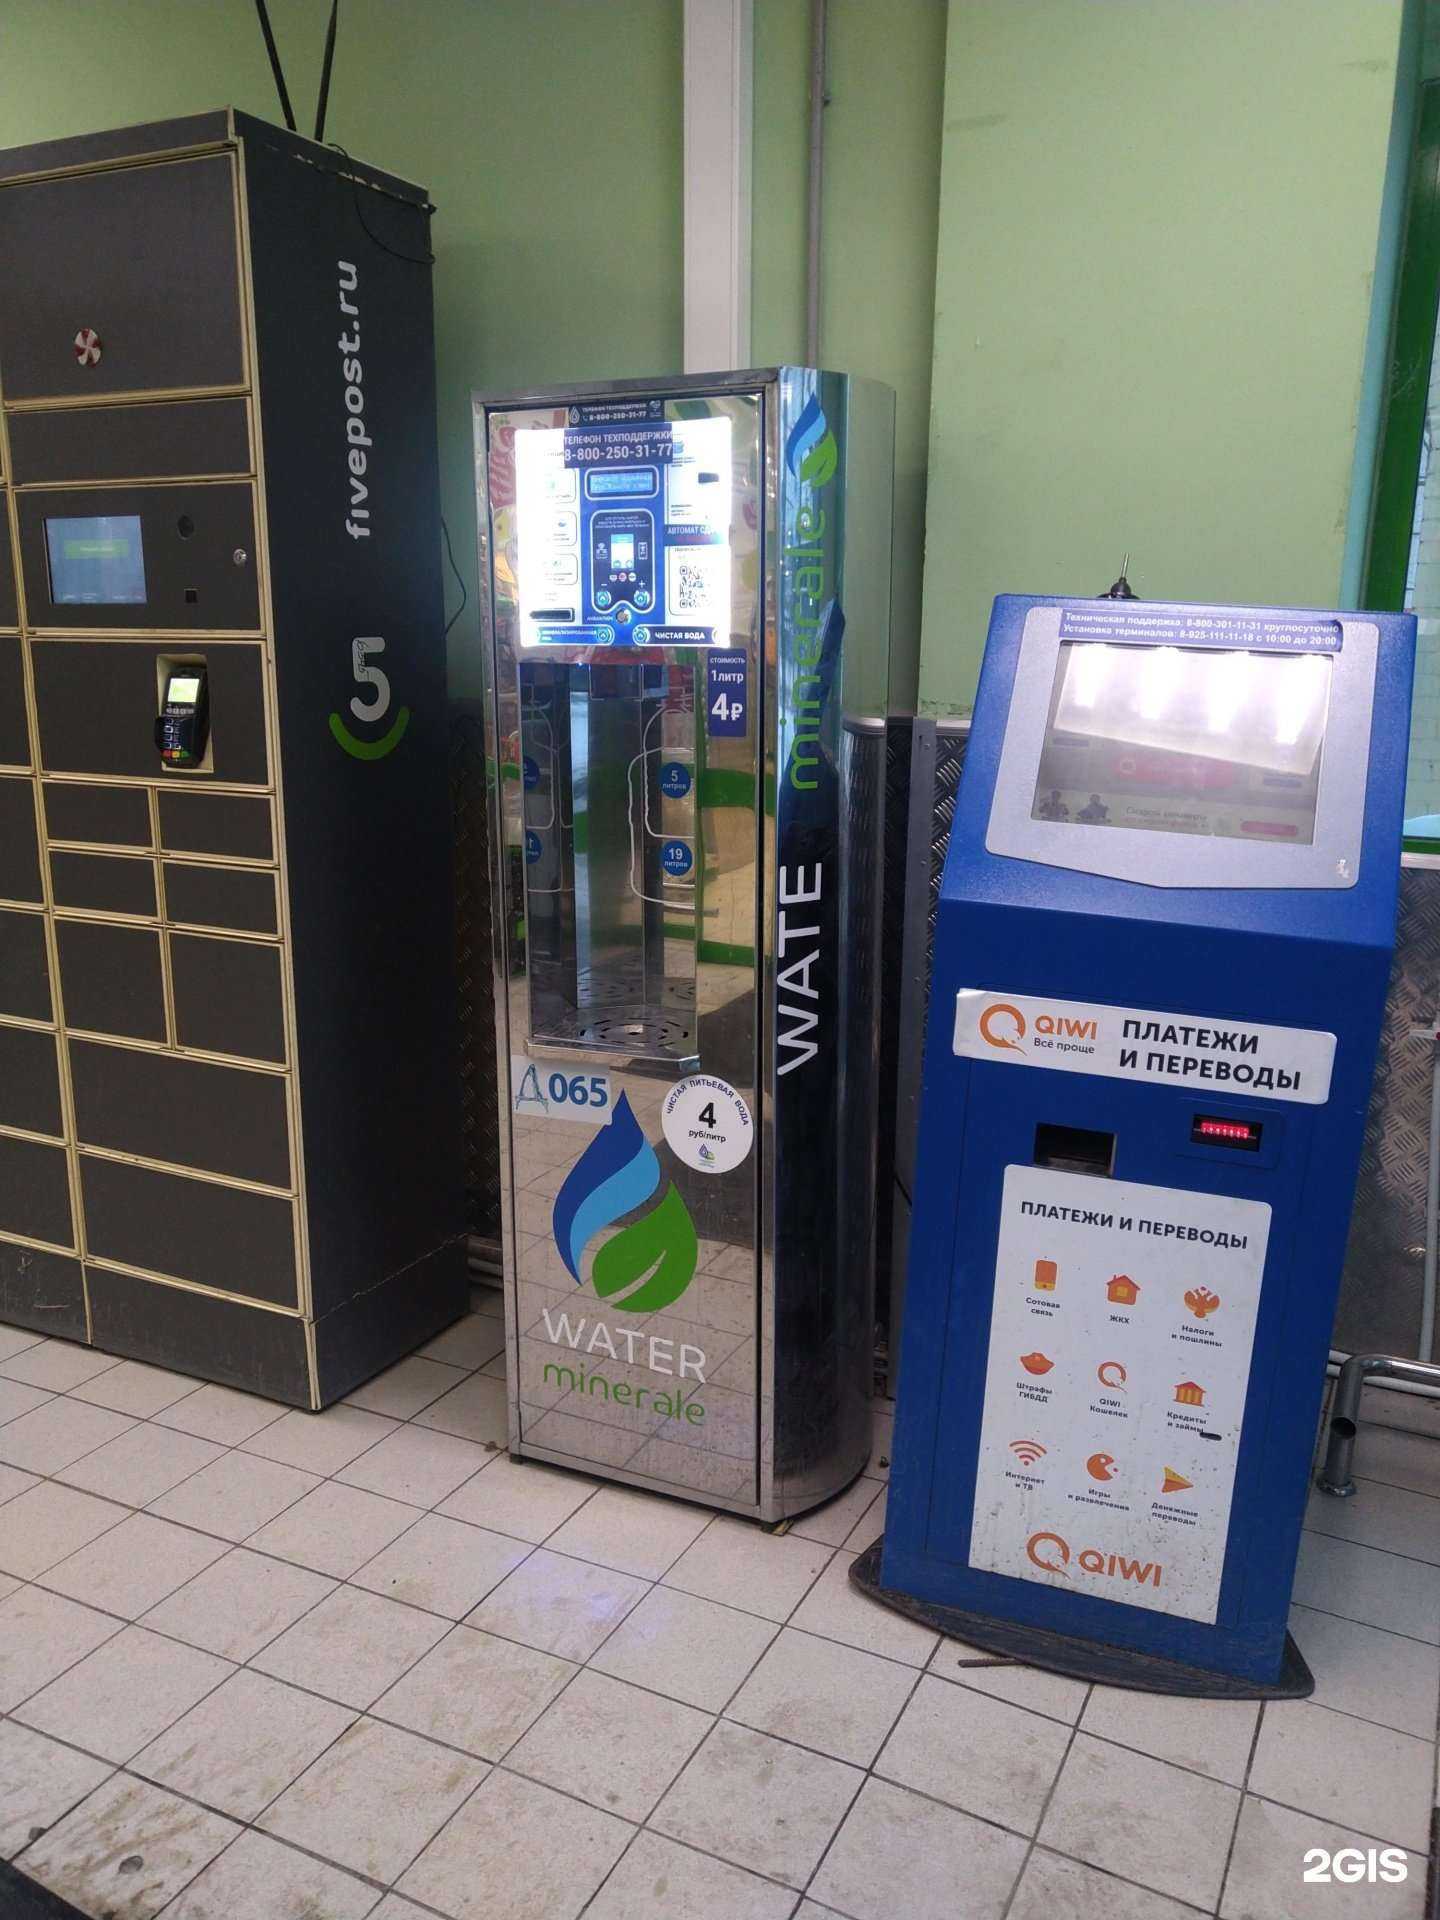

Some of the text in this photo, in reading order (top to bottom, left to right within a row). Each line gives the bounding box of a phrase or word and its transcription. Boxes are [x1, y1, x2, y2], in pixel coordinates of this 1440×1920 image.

[337, 260, 373, 540] fivepost.ru
[564, 430, 672, 445] ТЕЛЕФОН ТЕХПОДДЕРЖКИ
[564, 443, 672, 461] 8-800-250-31-77
[667, 525, 698, 535] АВТОМАТ
[1066, 612, 1125, 624] Техническая
[1264, 623, 1339, 634] круглосуточно
[655, 631, 706, 640] ЧИСТАЯ ВОДА
[1064, 624, 1112, 634] Установка
[1266, 633, 1292, 644] 10:00
[1293, 636, 1307, 645] до
[1309, 636, 1337, 645] 20:00
[780, 508, 827, 790] minerale
[710, 657, 746, 665] стоимость
[350, 637, 390, 722] 5
[671, 770, 679, 782] 5
[662, 782, 687, 790] литров
[668, 848, 683, 860] 19
[664, 860, 688, 869] литров
[1034, 1015, 1098, 1040] QIWI
[1122, 1019, 1259, 1054] ПЛАТЕЖИ
[1033, 1036, 1095, 1055] Всё проще
[1119, 1049, 1301, 1091] И ПЕРЕВОДЫ
[666, 1078, 749, 1126] ЧИСТАЯ ПИТЬЕВАЯ ВОДА
[698, 1102, 717, 1129] 4
[1020, 1201, 1248, 1250] ПЛАТЕЖИ И ПЕРЕВОДЫ
[1026, 1297, 1061, 1309] Сотовая
[1030, 1307, 1053, 1317] связь
[1109, 1314, 1130, 1324] ЖКХ
[1181, 1325, 1215, 1337] Налоги
[542, 1308, 706, 1384] WATER
[1179, 1335, 1223, 1347] пошлины
[543, 1363, 705, 1425] minerale
[1016, 1382, 1053, 1395] Штрафы
[1019, 1391, 1048, 1403] ГИБДД
[1099, 1398, 1121, 1408] QIWI
[1090, 1405, 1128, 1418] Кошелек
[1167, 1411, 1207, 1425] Кредиты
[1175, 1423, 1204, 1434] займы
[1005, 1471, 1045, 1485] Интернет
[1022, 1483, 1034, 1491] ТВ
[1088, 1488, 1111, 1500] Игры
[1075, 1494, 1130, 1512] развлечения
[1151, 1502, 1199, 1518] Денежные
[1151, 1512, 1197, 1526] переводы
[1078, 1550, 1162, 1587] QIWI
